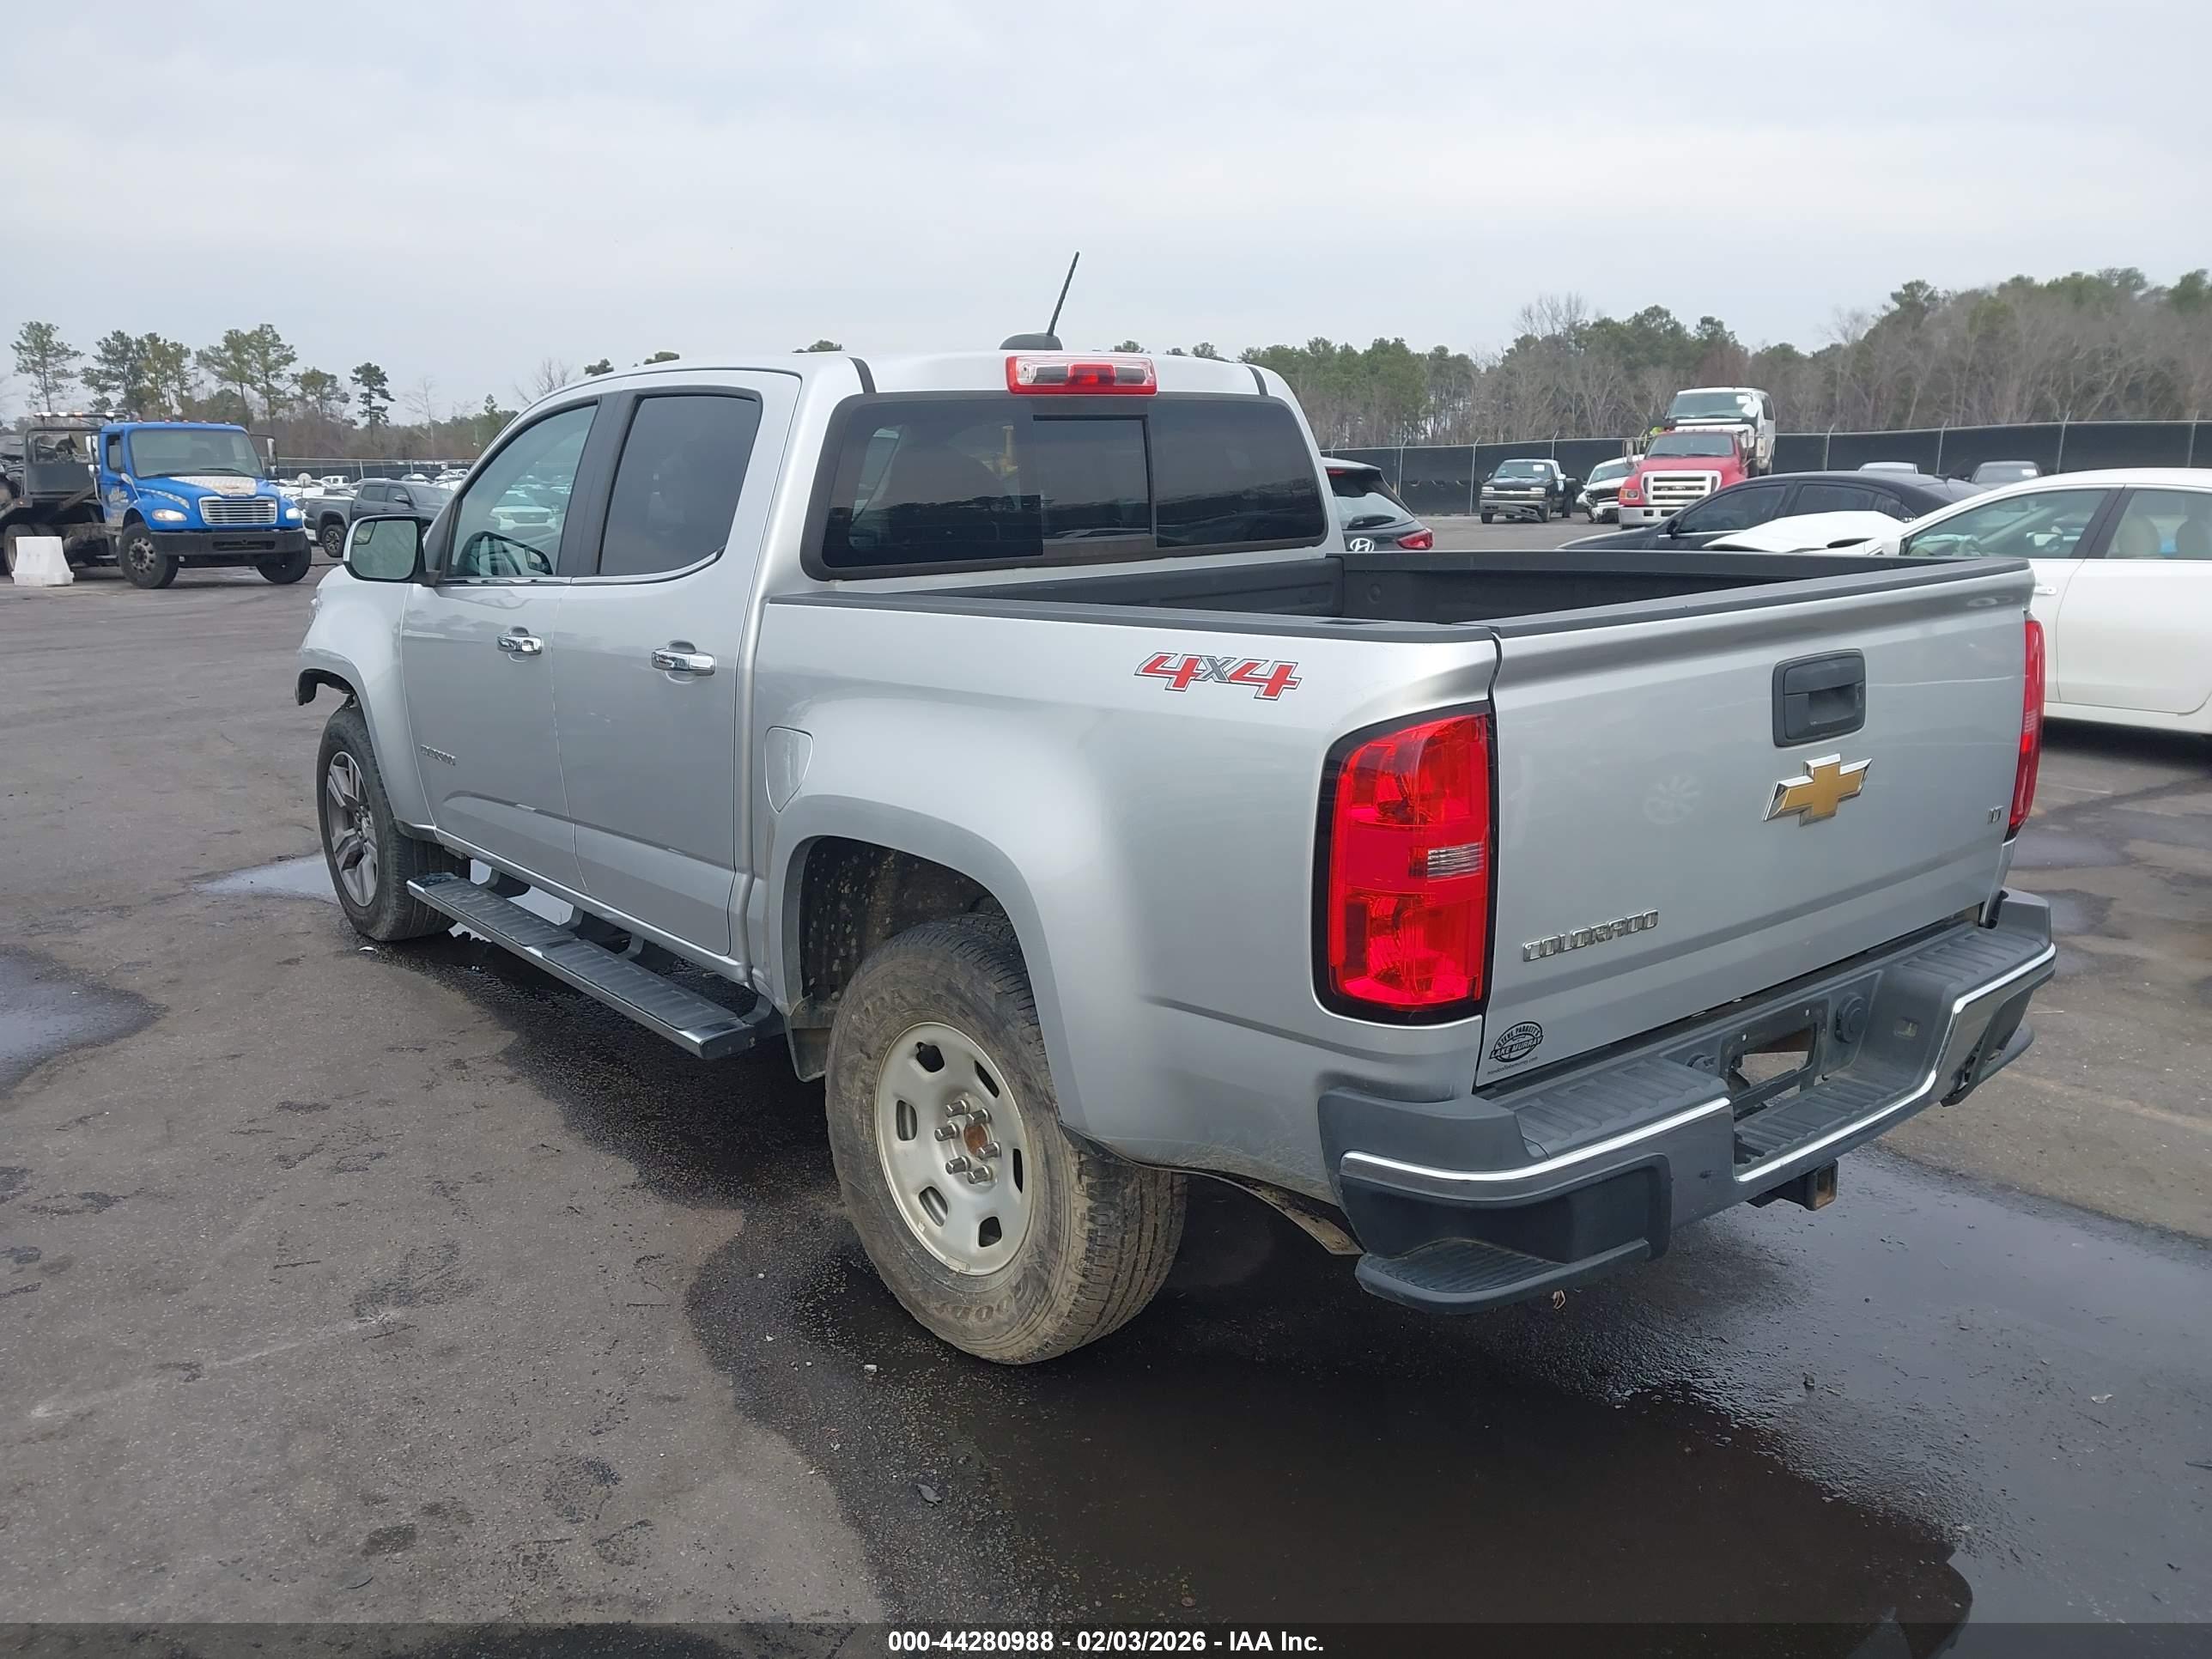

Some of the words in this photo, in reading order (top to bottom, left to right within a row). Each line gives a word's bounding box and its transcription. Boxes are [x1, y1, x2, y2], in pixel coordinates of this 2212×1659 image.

[1522, 908, 1660, 963] COLORADO
[1491, 1046, 1511, 1058] LAKE
[1511, 1036, 1543, 1052] MURRAY
